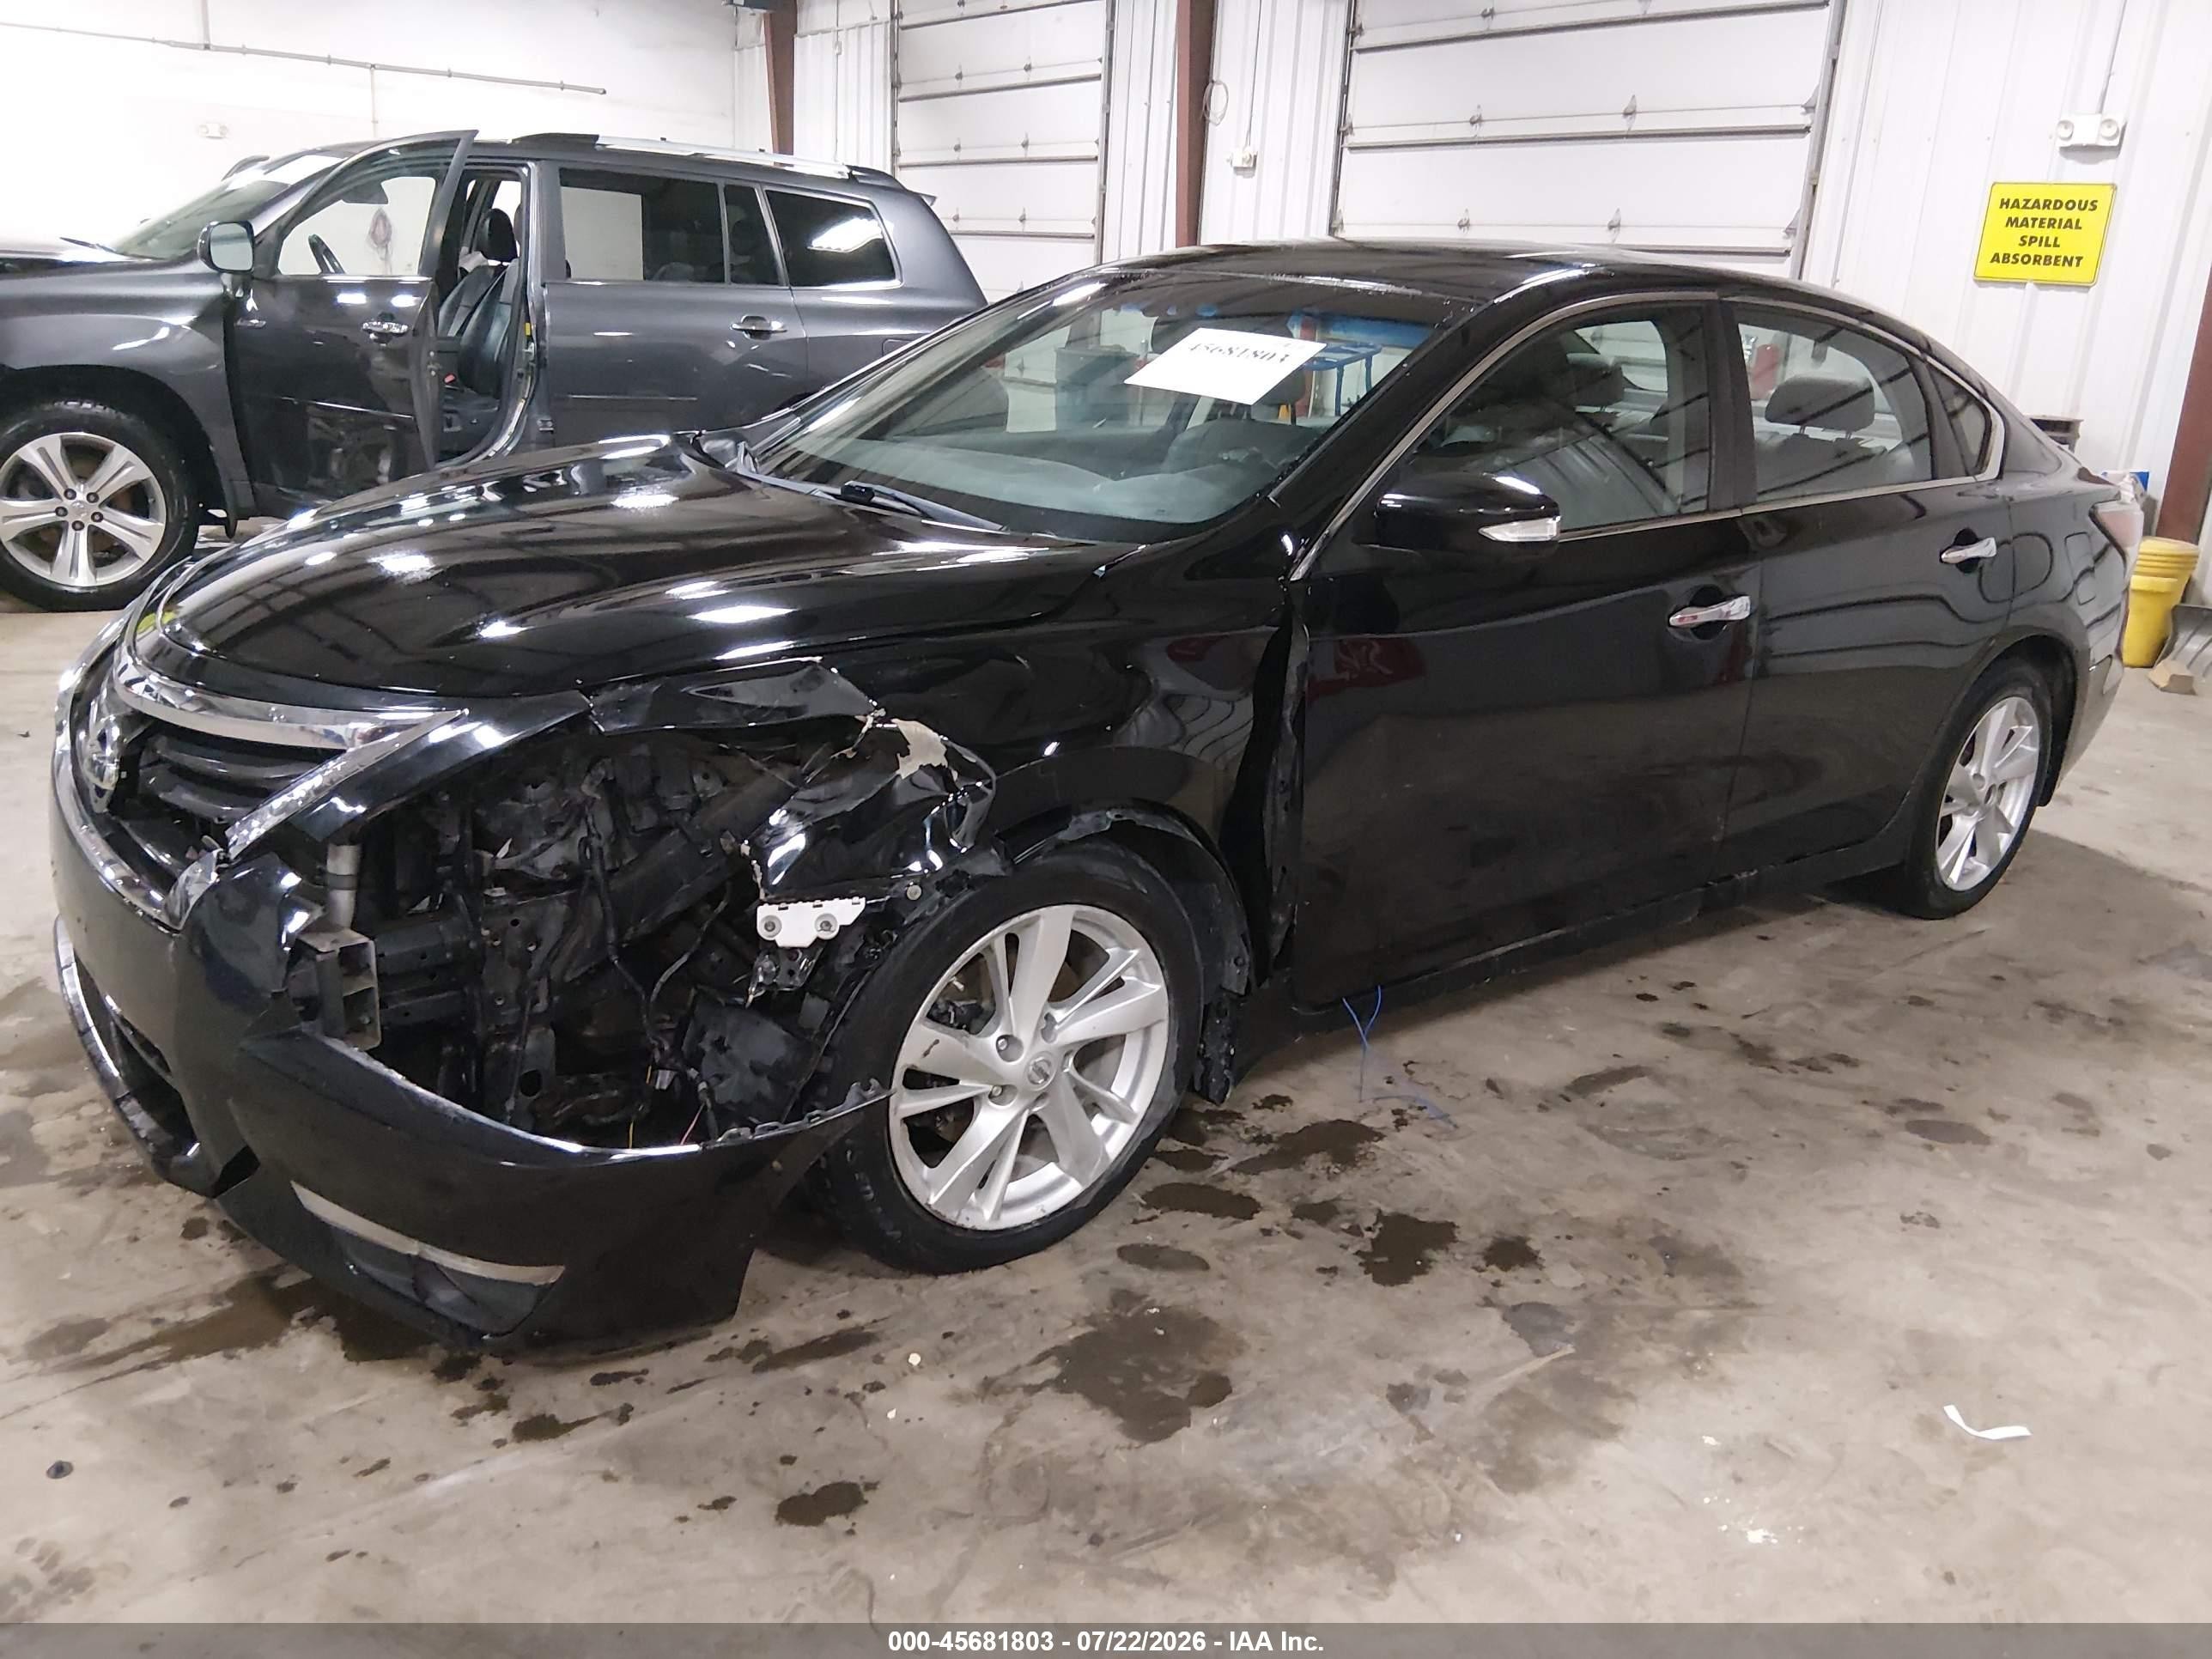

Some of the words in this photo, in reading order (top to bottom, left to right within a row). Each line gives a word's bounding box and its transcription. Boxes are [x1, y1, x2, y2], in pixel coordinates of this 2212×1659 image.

[1999, 198, 2099, 211] HAZARDOUS
[2005, 216, 2082, 230] MATERIAL
[2018, 235, 2061, 248] SPILL
[1990, 252, 2084, 268] ABSORBENT
